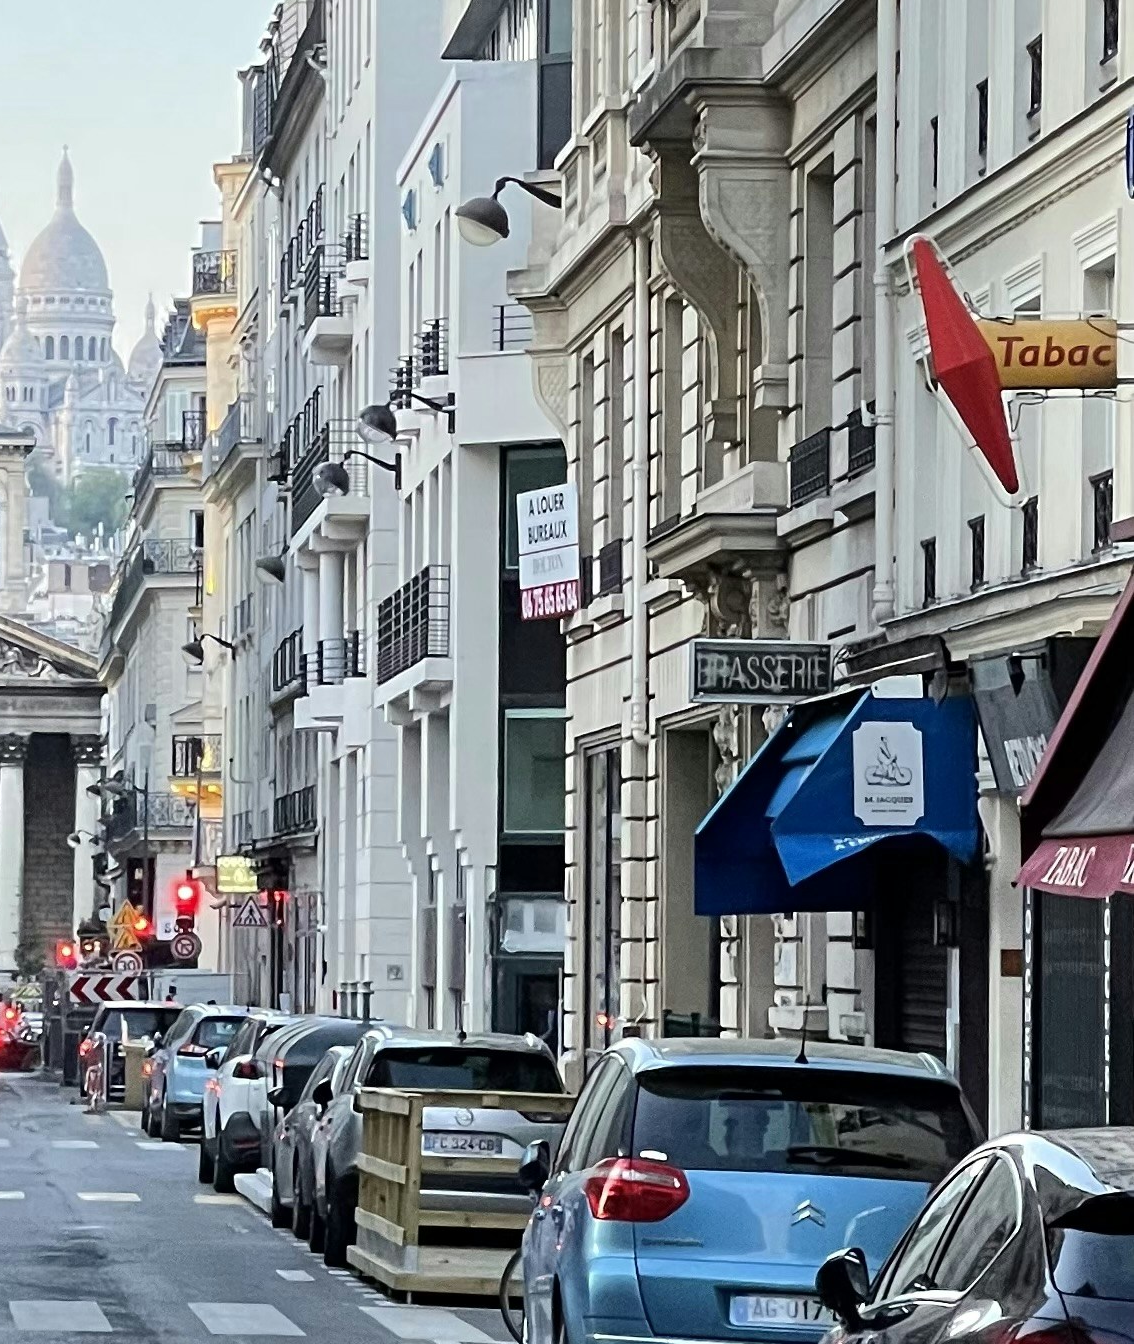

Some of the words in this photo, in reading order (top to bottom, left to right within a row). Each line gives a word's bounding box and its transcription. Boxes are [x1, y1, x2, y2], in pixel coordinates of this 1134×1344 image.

[997, 336, 1112, 367] Tabac
[529, 500, 535, 517] A
[537, 493, 565, 515] LOUER
[528, 520, 568, 545] BUREAUX
[696, 654, 827, 690] BRASSERIE
[1040, 846, 1097, 888] TABAC
